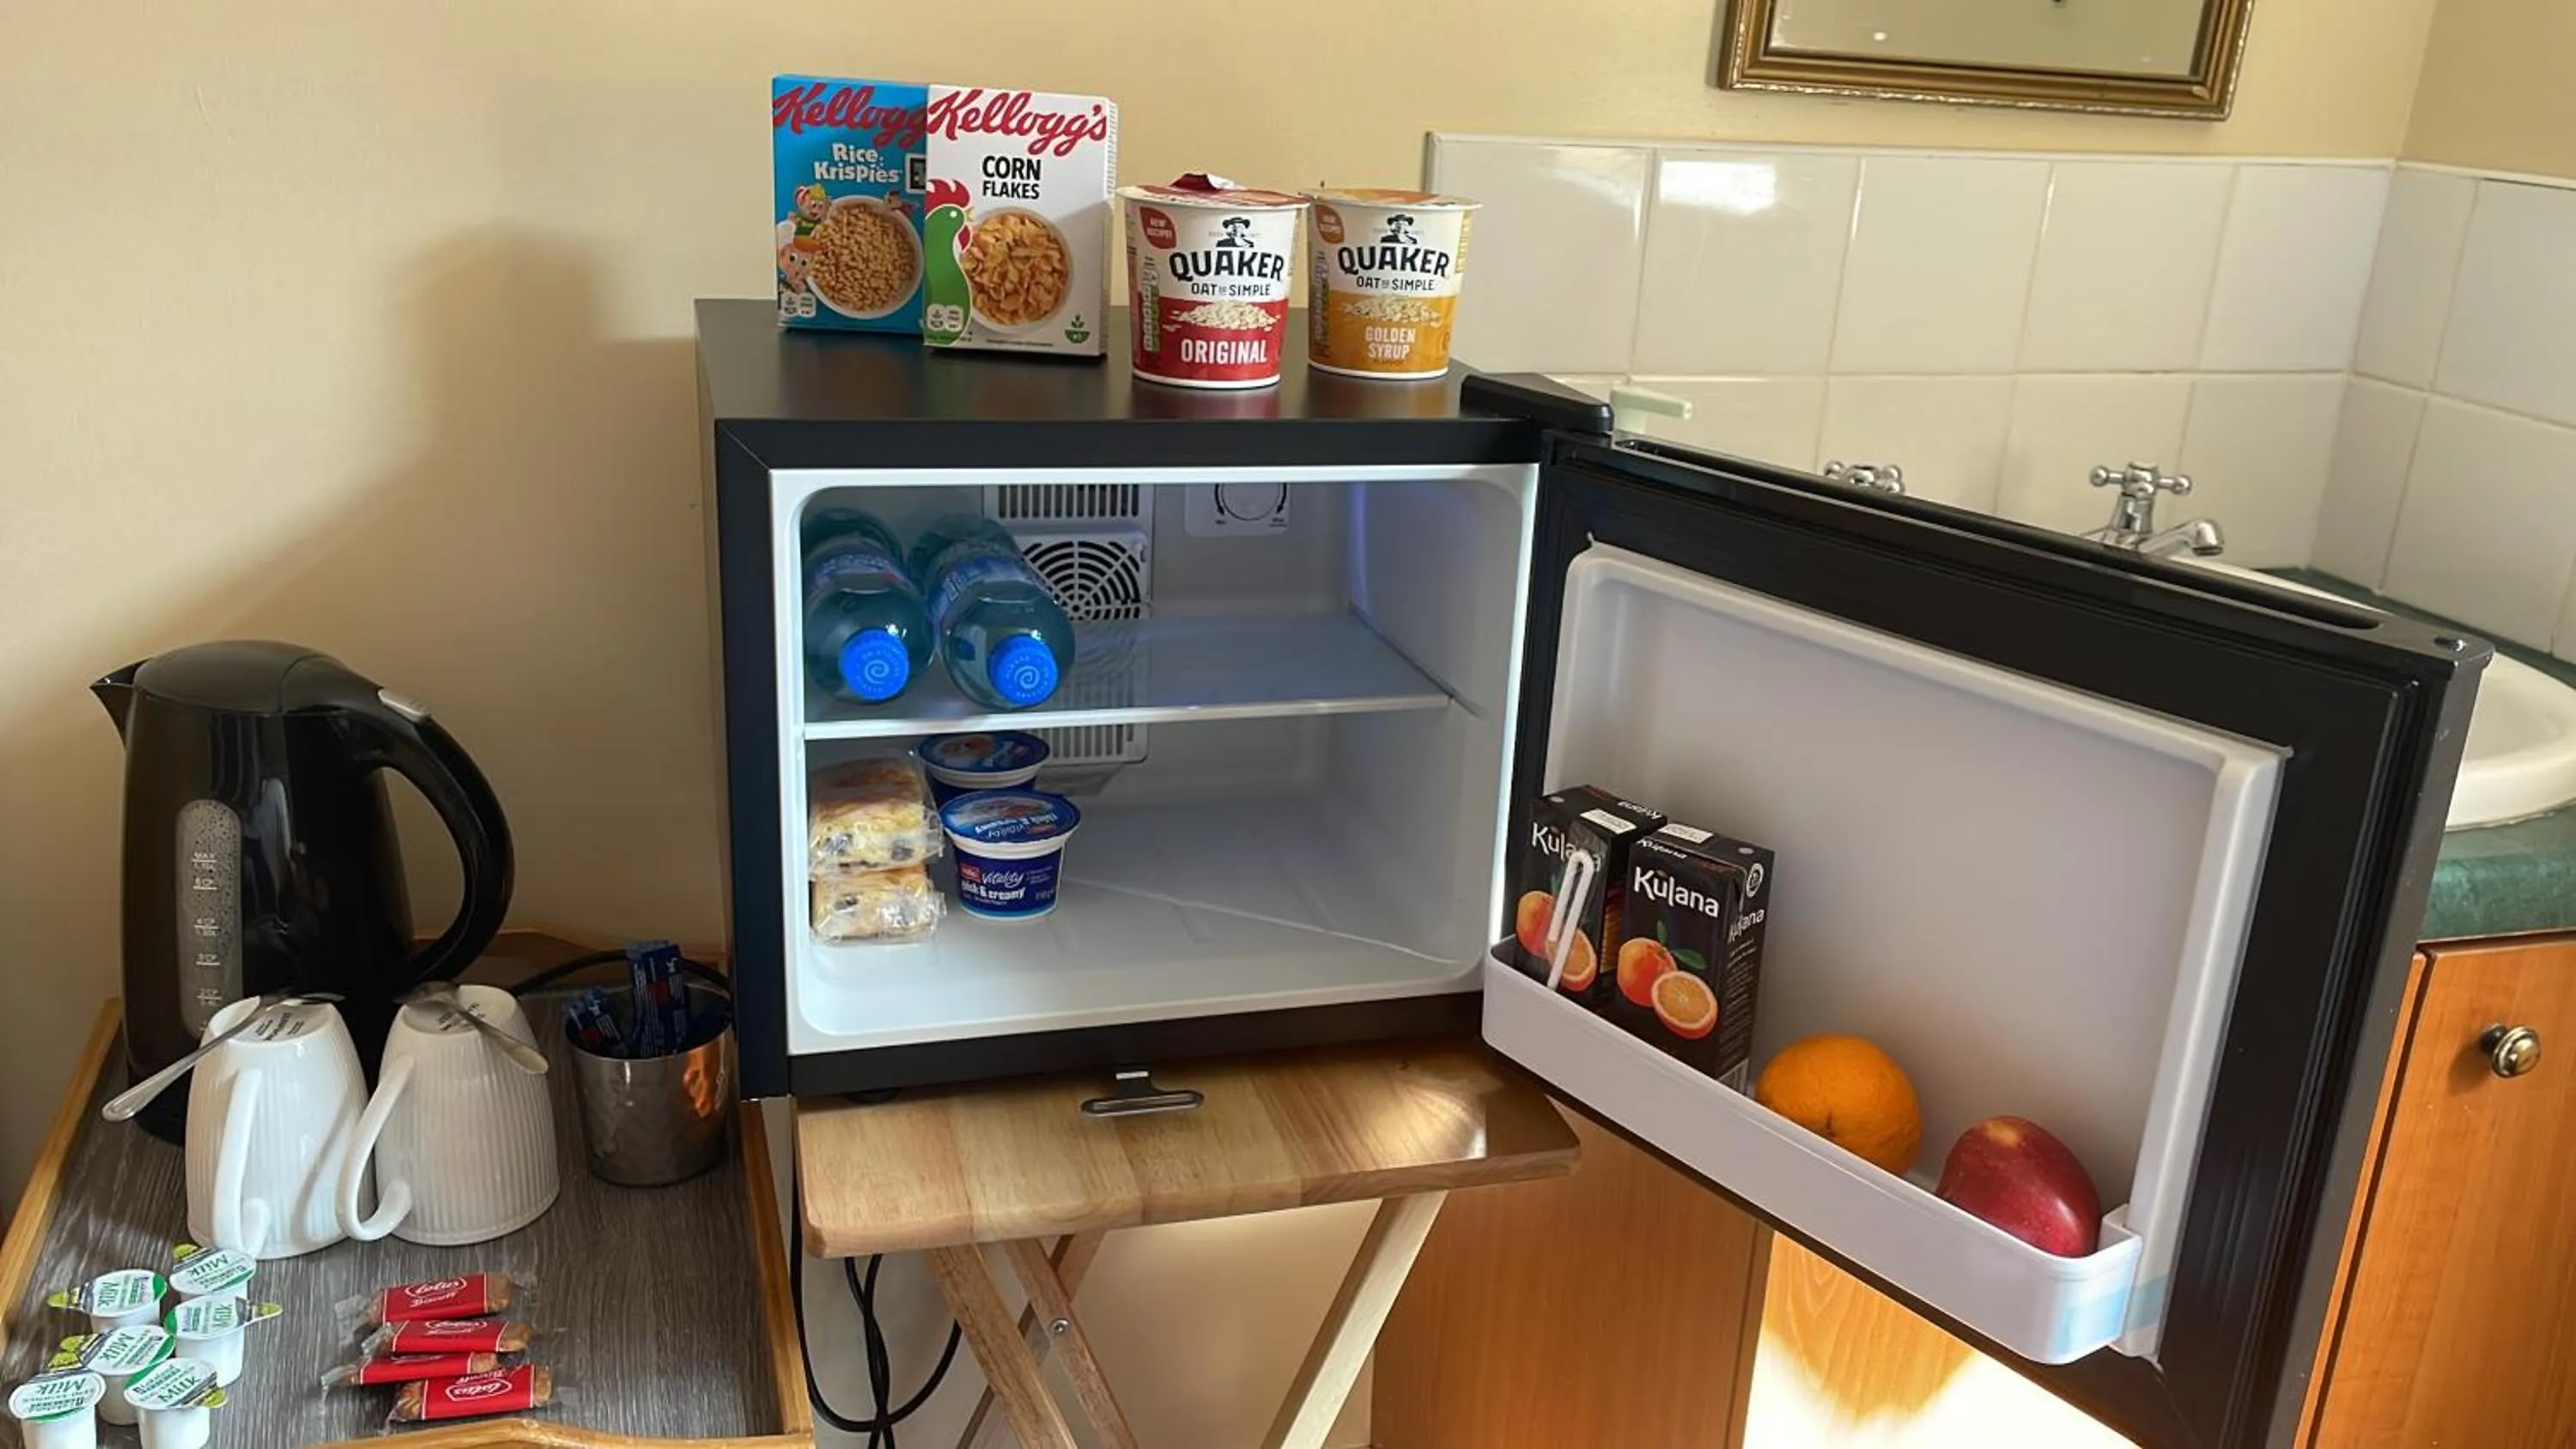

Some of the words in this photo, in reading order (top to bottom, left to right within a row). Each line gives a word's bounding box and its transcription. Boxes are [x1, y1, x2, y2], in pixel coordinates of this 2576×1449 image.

[927, 88, 1108, 157] Kellogg's
[832, 143, 878, 163] Rice
[813, 161, 900, 184] Krispies
[981, 155, 1042, 181] CORN
[982, 180, 1041, 200] FLAKES
[1169, 250, 1285, 282] QUAKER
[1337, 246, 1450, 278] QUAKER
[1191, 282, 1217, 295] OAT
[1229, 284, 1272, 296] SIMPLE
[1356, 276, 1381, 288] OAT
[1391, 278, 1436, 291] SIMPLE
[1364, 326, 1416, 343] GOLDEN
[1181, 338, 1268, 365] ORIGINAL
[1367, 342, 1410, 359] SYRUP
[1531, 822, 1602, 873] Kulaa
[981, 870, 1025, 889] Vitality
[987, 886, 1026, 900] creamy
[1634, 866, 1720, 919] Kulana
[191, 1253, 229, 1276] Milk
[97, 1281, 121, 1309] Milk
[214, 1303, 234, 1327] Milk
[99, 1333, 136, 1361] Milk
[39, 1377, 88, 1397] Milk
[157, 1376, 202, 1404] Milk
